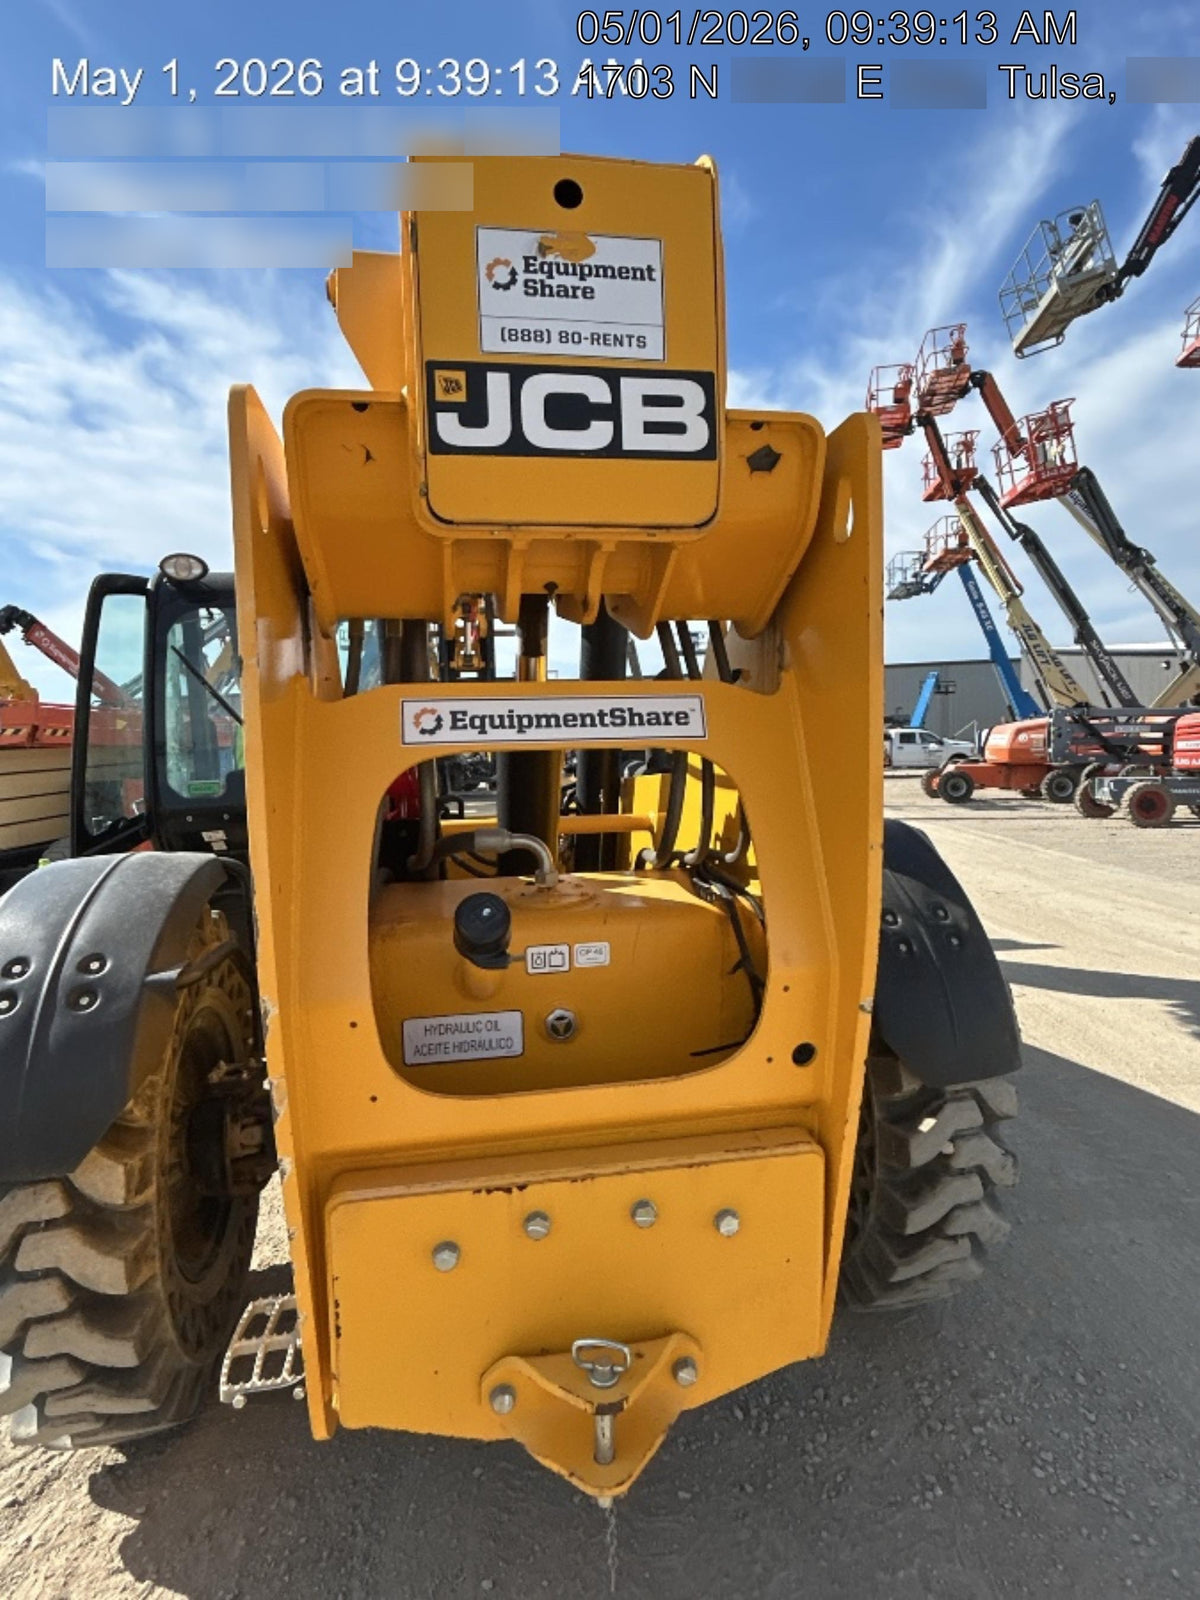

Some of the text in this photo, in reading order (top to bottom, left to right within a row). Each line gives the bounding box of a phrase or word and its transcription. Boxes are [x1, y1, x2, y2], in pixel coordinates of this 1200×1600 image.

[522, 255, 656, 282] Equipment
[523, 279, 596, 301] Share
[500, 326, 647, 349] (888) 80-RENTS
[435, 371, 710, 452] JCB
[449, 707, 690, 735] EquipmentShare
[424, 1019, 502, 1037] HYDRAULIC OIL
[413, 1041, 450, 1057] ACEITE
